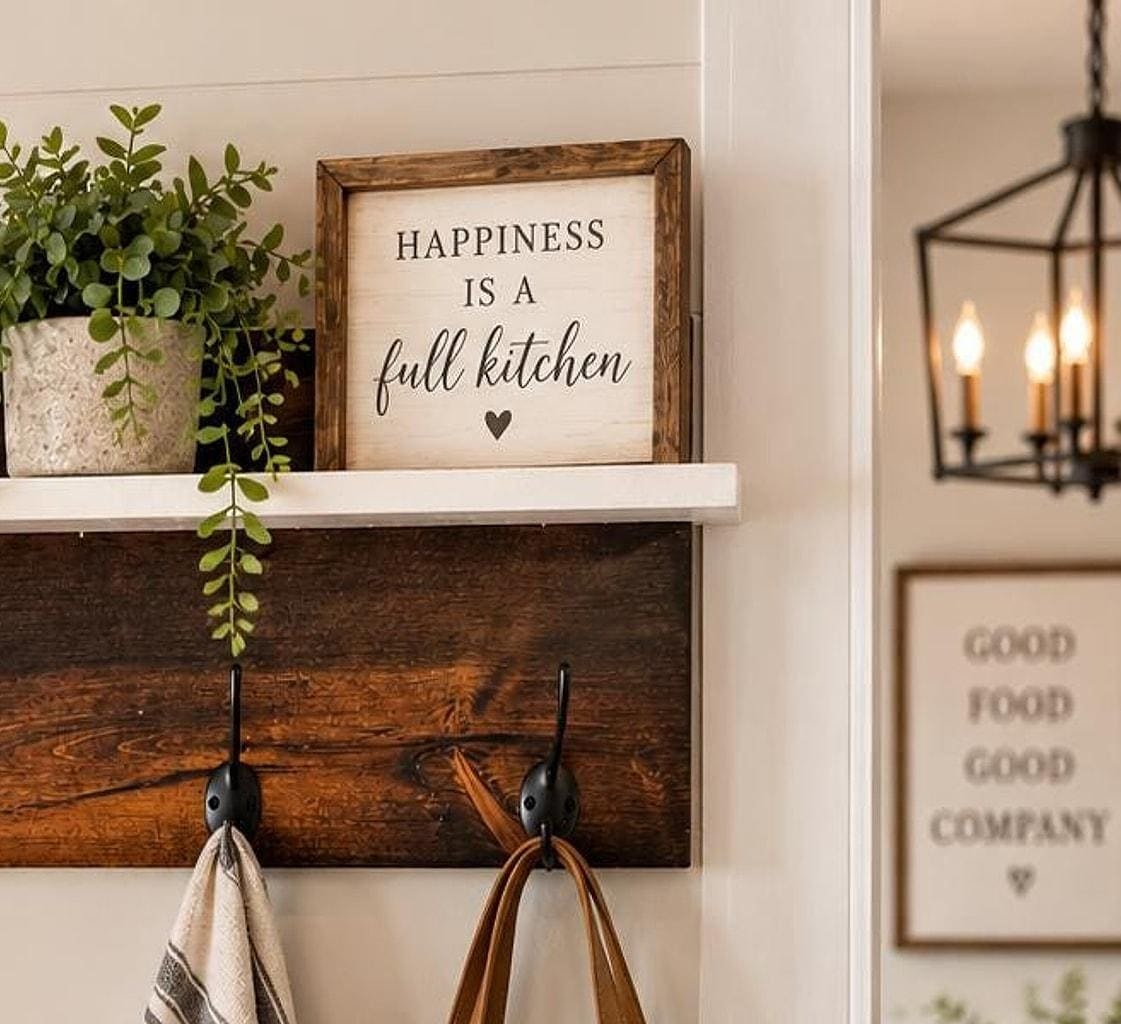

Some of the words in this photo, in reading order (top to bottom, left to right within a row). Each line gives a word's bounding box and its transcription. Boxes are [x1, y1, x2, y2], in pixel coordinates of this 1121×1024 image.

[396, 219, 604, 261] HAPPINESS
[464, 277, 495, 307] IS
[514, 275, 536, 305] A
[374, 327, 468, 417] full
[476, 320, 632, 389] kitchen
[963, 627, 1076, 663] GOOD
[968, 687, 1074, 723] FOOD
[964, 748, 1076, 784] GOOD
[930, 809, 1107, 844] COMPANY
